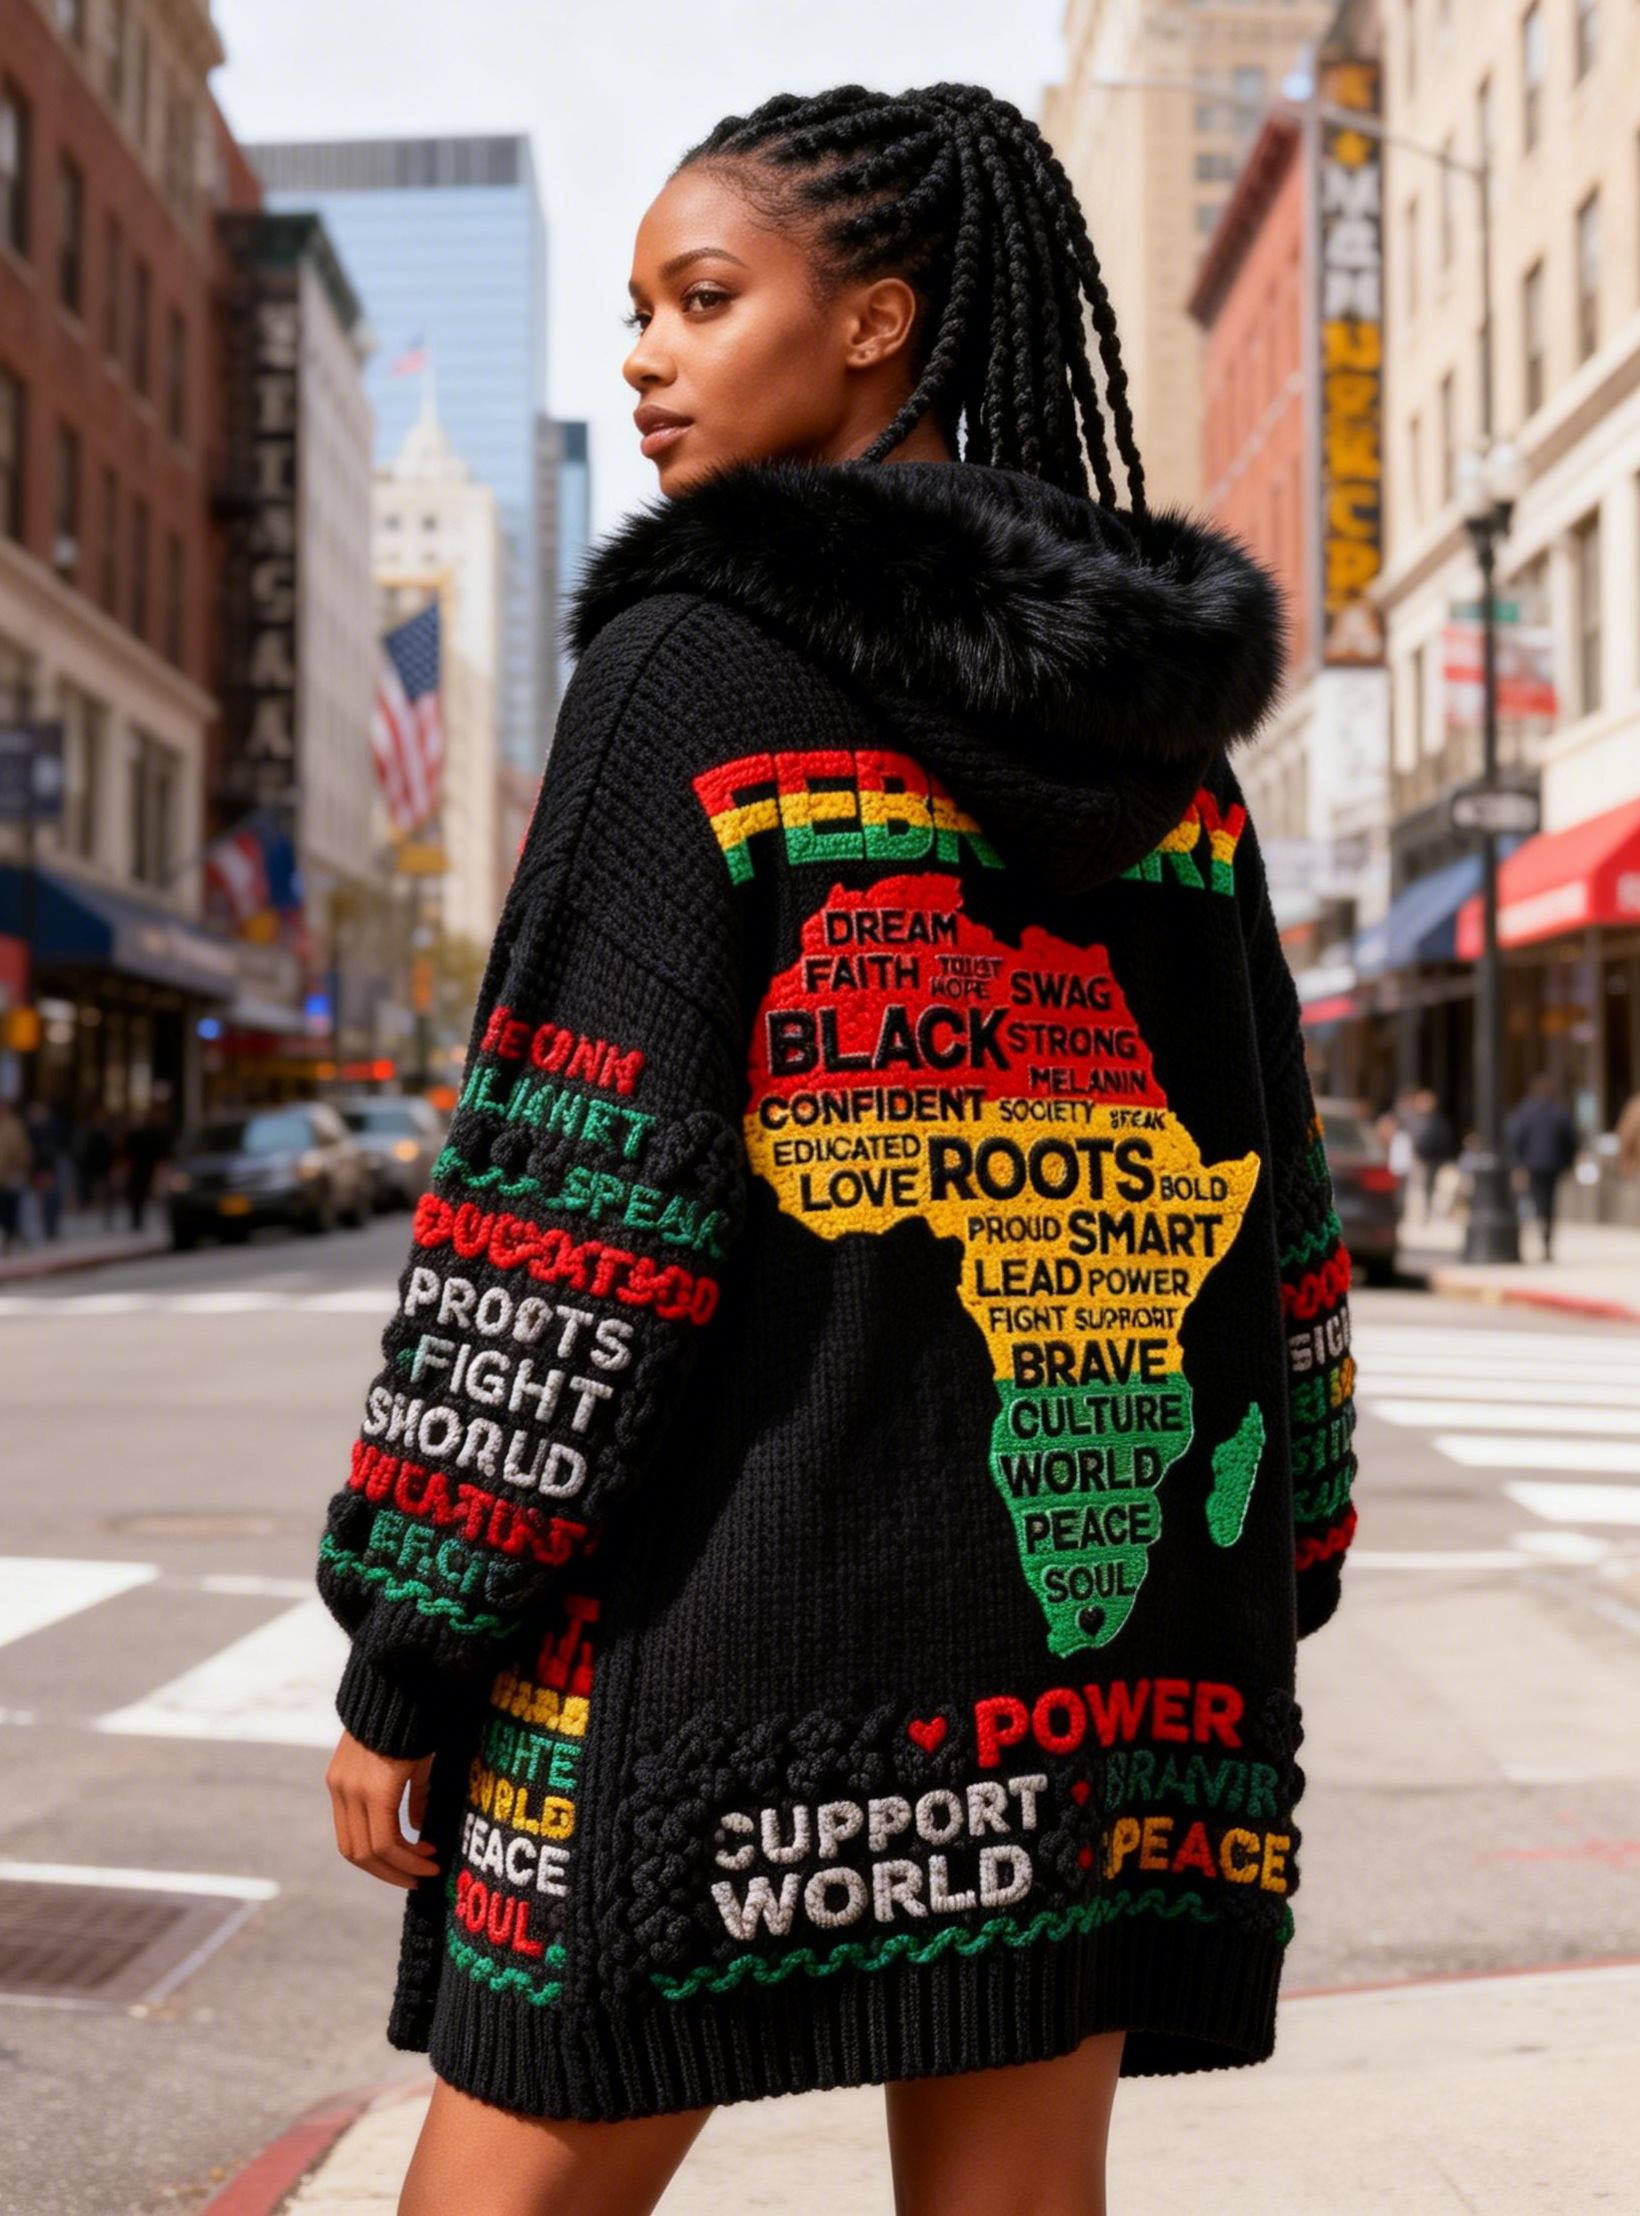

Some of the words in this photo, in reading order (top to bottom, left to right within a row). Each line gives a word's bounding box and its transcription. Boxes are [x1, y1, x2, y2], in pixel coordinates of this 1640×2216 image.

[824, 908, 959, 946] DREAM
[803, 955, 920, 992] FAITH
[1009, 970, 1111, 1010] SWAG
[764, 1003, 1011, 1078] BLACK
[1006, 1023, 1137, 1058] STRONG
[1028, 1067, 1147, 1094] MELANIN
[758, 1087, 985, 1130] CONFIDENT
[998, 1100, 1096, 1124] SOCIETY
[772, 1134, 922, 1167] EDUCATED
[927, 1136, 1156, 1203] ROOTS
[800, 1168, 920, 1212] LOVE
[1160, 1176, 1228, 1202] BOLD
[967, 1215, 1062, 1244] PROUD
[1068, 1209, 1223, 1258] SMART
[974, 1258, 1082, 1298] LEAD
[1088, 1268, 1191, 1298] POWER
[402, 1266, 636, 1372] PROOTS
[989, 1306, 1067, 1333] FIGHT
[408, 1333, 614, 1433] FIGHT
[1011, 1338, 1169, 1388] BRAVE
[1009, 1394, 1184, 1440] CULTURE
[1000, 1447, 1163, 1498] WORLD
[1023, 1504, 1154, 1555] PEACE
[1042, 1562, 1136, 1603] SOUL
[975, 1678, 1244, 1768] POWER
[1110, 1815, 1292, 1894] PEACE
[710, 1844, 1034, 1941] WORLD
